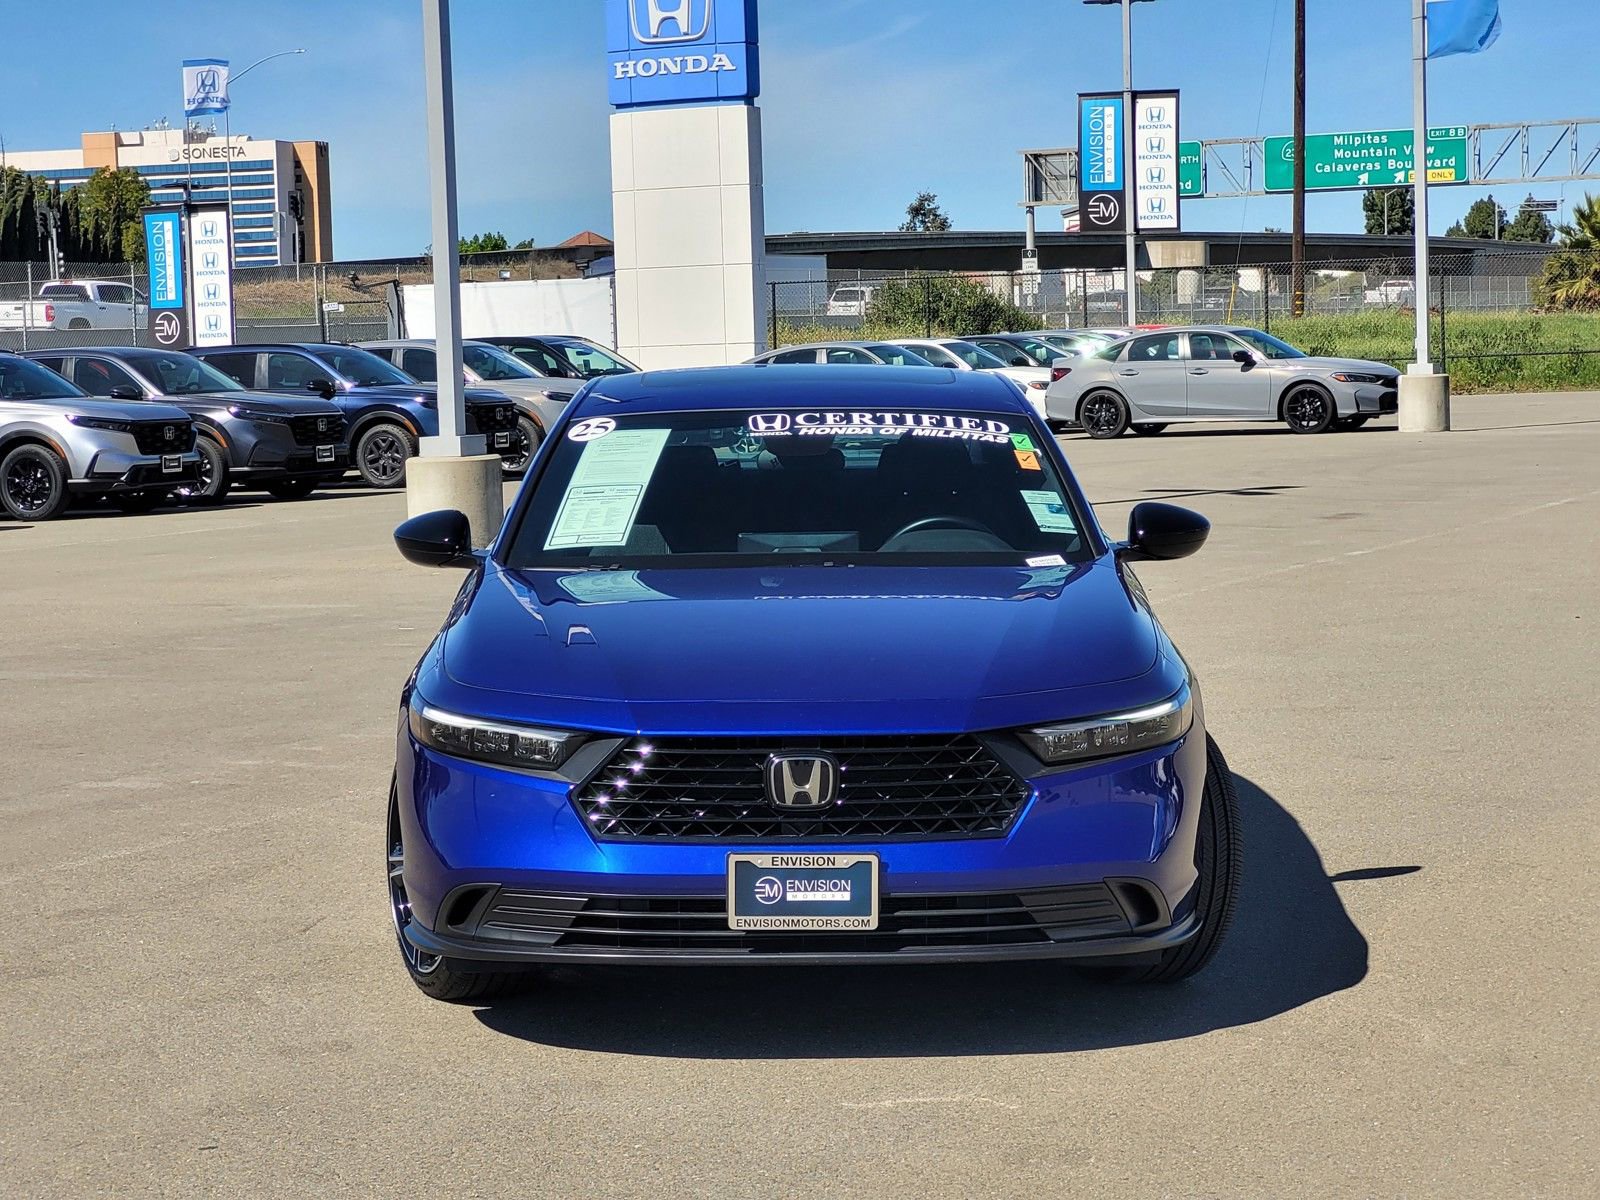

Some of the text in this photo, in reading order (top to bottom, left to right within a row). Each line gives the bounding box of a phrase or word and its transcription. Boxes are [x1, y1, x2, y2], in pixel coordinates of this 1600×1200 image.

[614, 54, 736, 79] HONDA
[1090, 107, 1104, 183] ENVISION
[1333, 134, 1388, 147] Milpitas
[182, 146, 247, 160] SONESTA
[1334, 144, 1435, 159] Mountain Vw
[1315, 156, 1456, 173] Calaveras Bouvard
[1431, 171, 1453, 179] ONLY
[151, 221, 167, 301] ENVISION
[196, 269, 226, 277] HONDA
[197, 300, 227, 308] HONDA
[571, 419, 612, 438] 25
[795, 411, 1010, 434] CERTIFIED
[798, 426, 1010, 444] HONDA OF MILPITAS
[771, 856, 836, 867] ENVISION
[786, 880, 851, 892] ENVISION
[736, 918, 871, 928] ENVISIONMOTORS.COM
